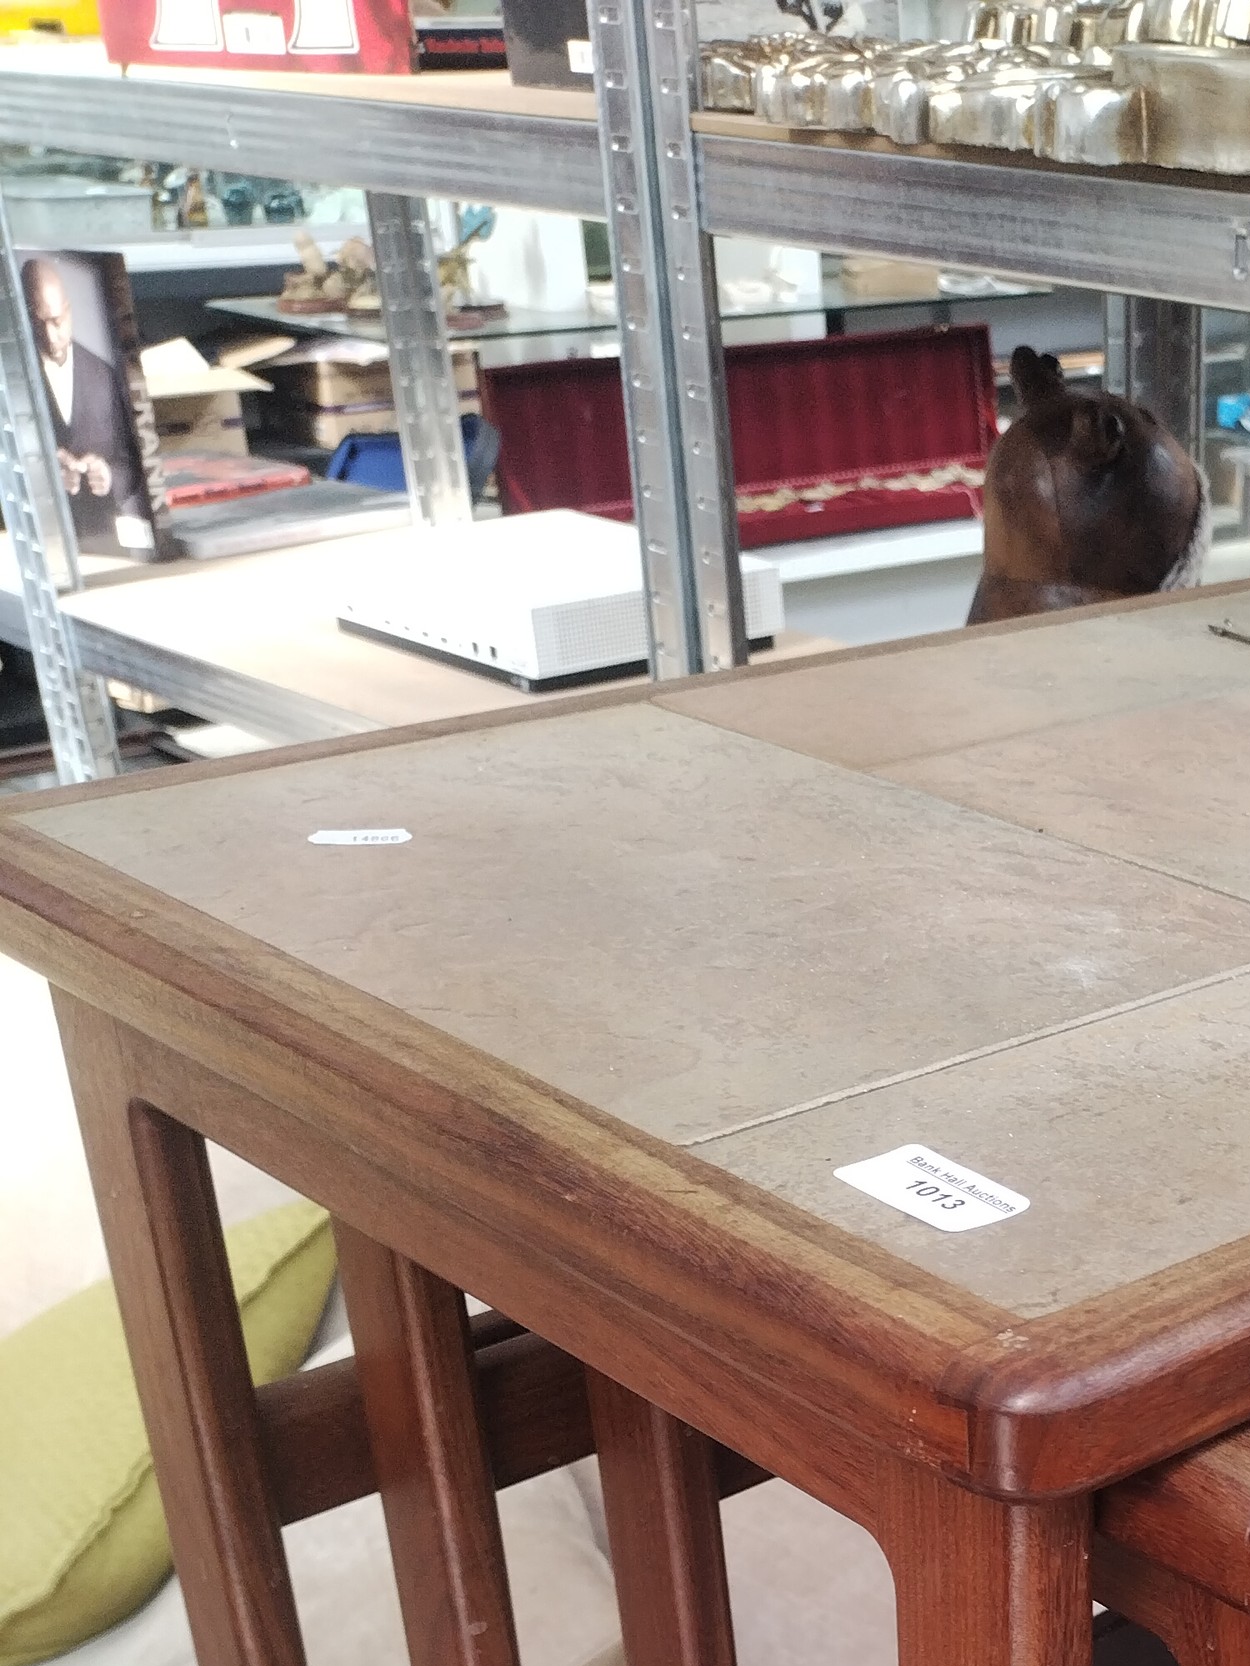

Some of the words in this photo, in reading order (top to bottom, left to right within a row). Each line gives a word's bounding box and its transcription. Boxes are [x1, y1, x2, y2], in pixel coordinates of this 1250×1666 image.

[905, 1179, 966, 1210] 1013
[909, 1155, 941, 1174] Bank
[940, 1171, 967, 1187] Hall
[963, 1183, 1017, 1213] Auctions
